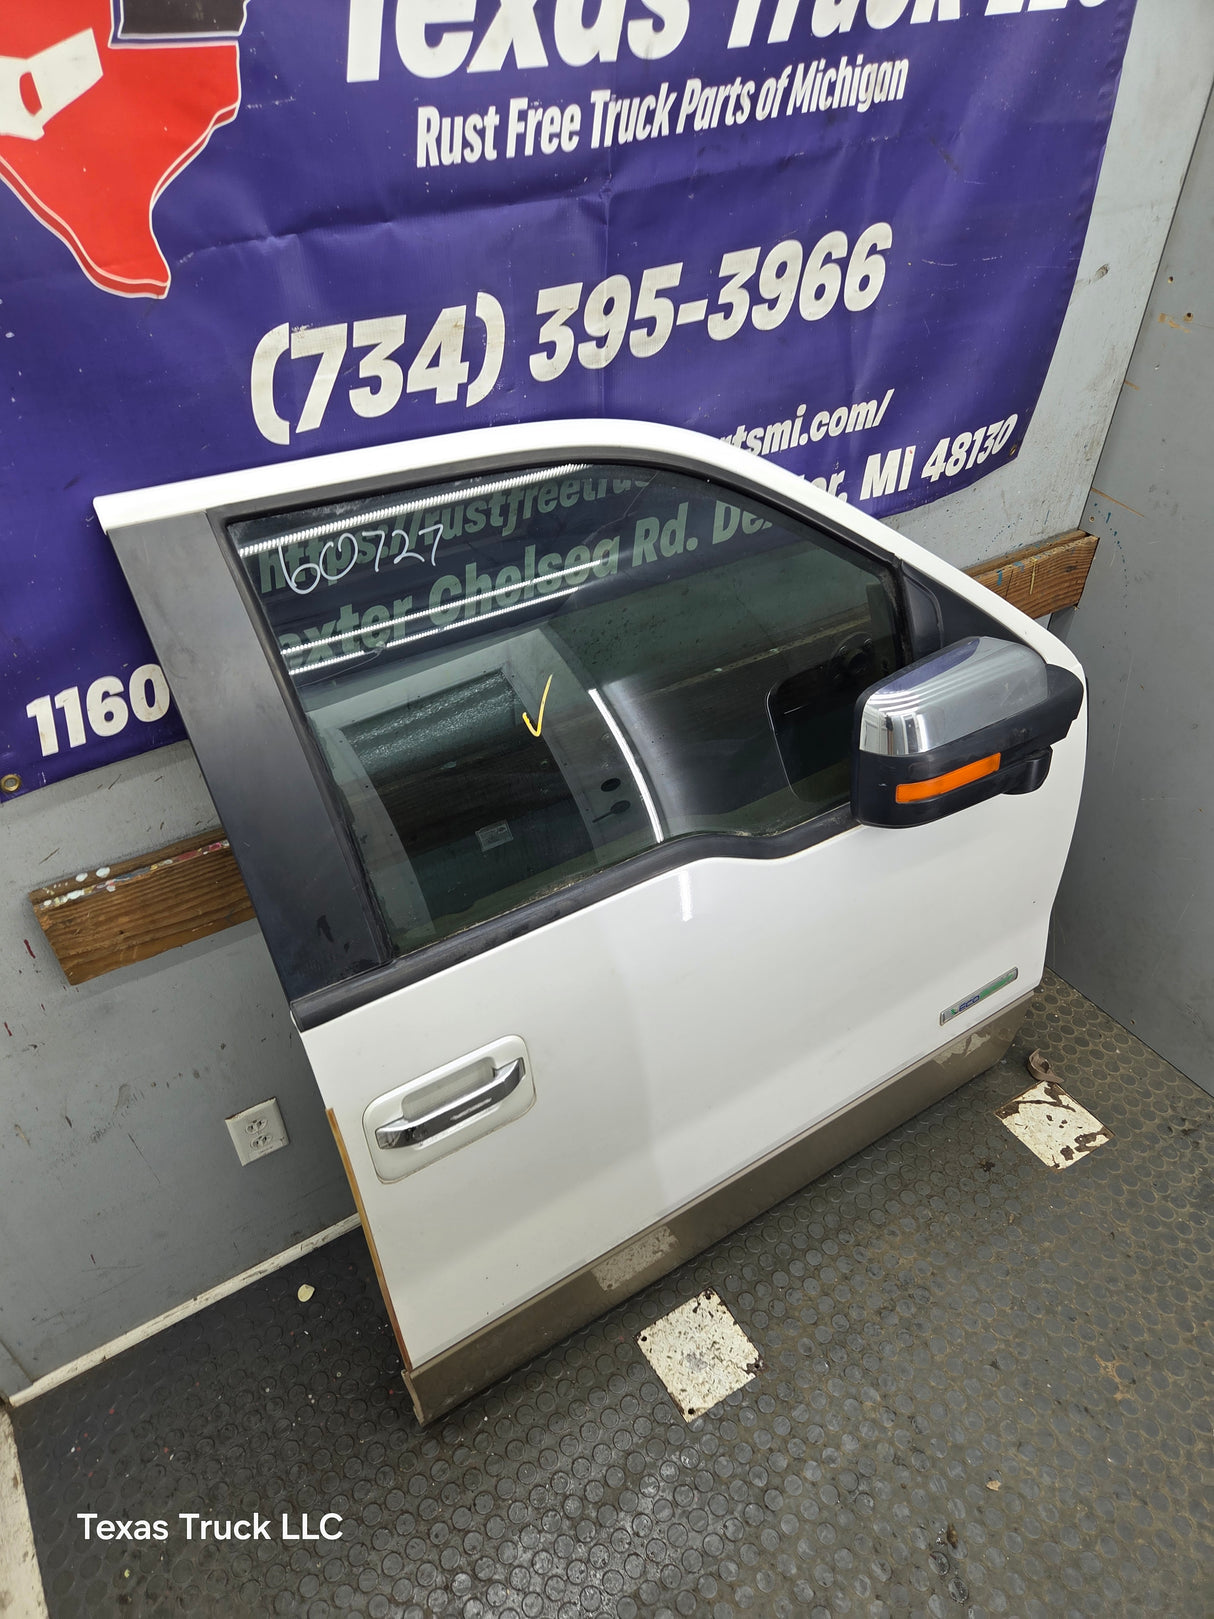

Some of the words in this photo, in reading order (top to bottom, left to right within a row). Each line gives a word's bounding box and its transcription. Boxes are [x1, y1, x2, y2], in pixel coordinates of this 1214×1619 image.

[416, 105, 500, 168] Rust
[506, 97, 582, 159] Free
[590, 82, 677, 149] Truck
[676, 75, 755, 134] Parts
[755, 66, 791, 121] of
[786, 54, 909, 116] Michigan
[250, 291, 506, 446] (734)
[529, 222, 893, 383] 395-3966
[26, 663, 170, 757] 1160
[428, 535, 620, 626] Chelsea
[632, 502, 698, 567] Rd.
[859, 445, 917, 501] MI
[921, 413, 1018, 483] 48130
[277, 523, 444, 595] 60727
